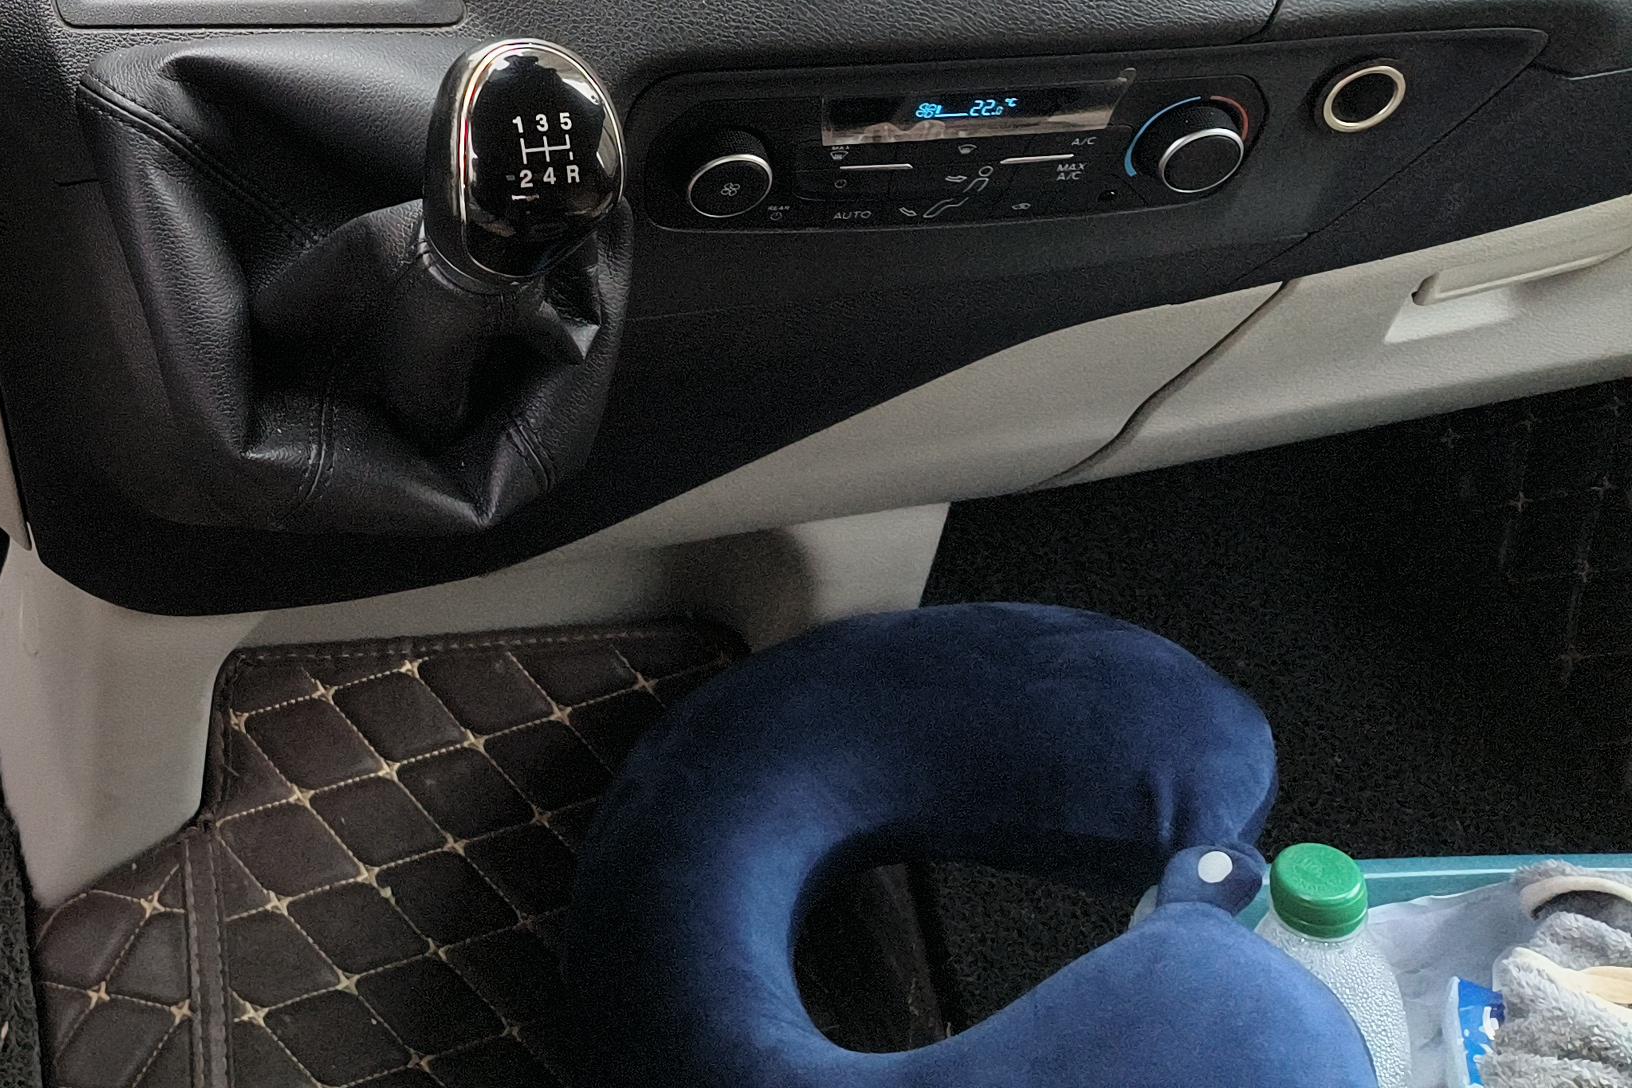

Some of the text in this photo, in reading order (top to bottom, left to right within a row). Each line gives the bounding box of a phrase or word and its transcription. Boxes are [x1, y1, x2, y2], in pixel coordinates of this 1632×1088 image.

[512, 112, 572, 133] 1 3 5
[1071, 136, 1097, 146] A/C
[1056, 163, 1085, 172] MAX
[519, 164, 580, 188] 2 4 R
[1056, 172, 1080, 181] A/C
[833, 211, 871, 220] AUTO
